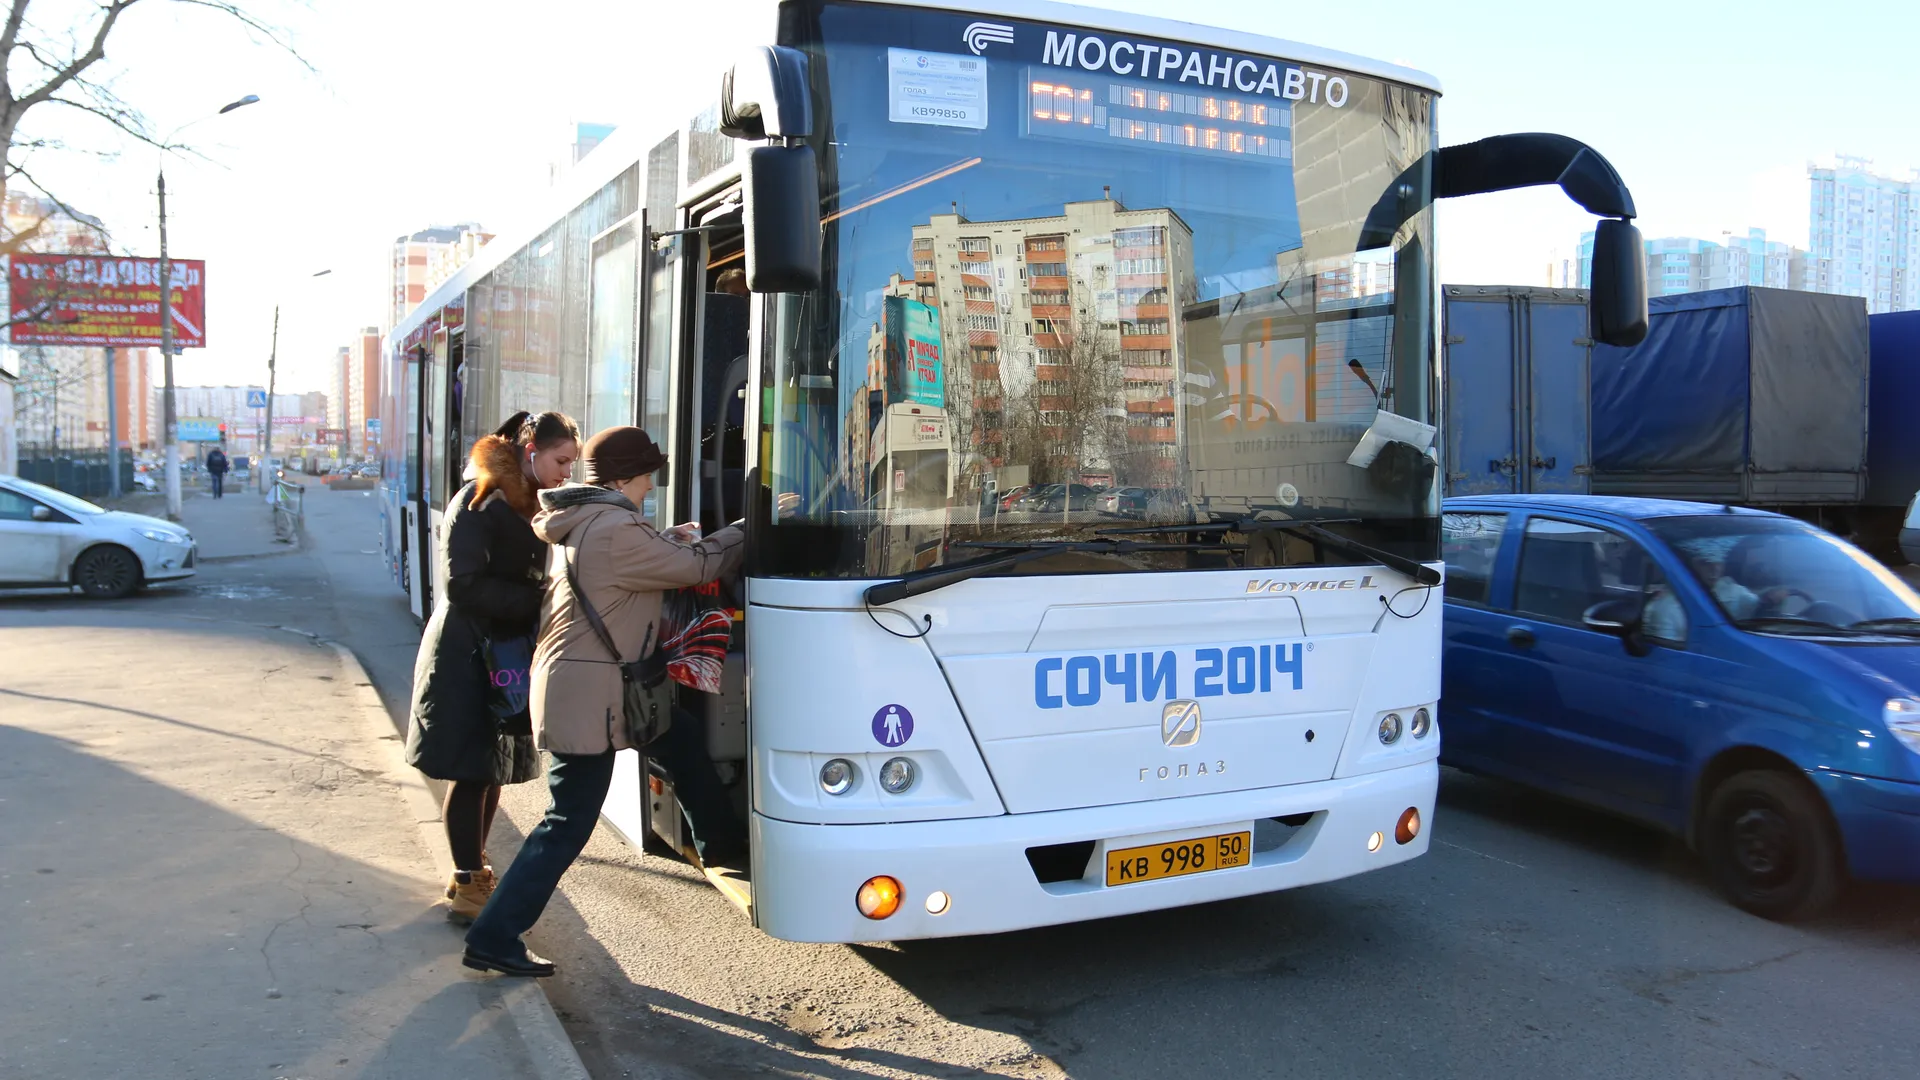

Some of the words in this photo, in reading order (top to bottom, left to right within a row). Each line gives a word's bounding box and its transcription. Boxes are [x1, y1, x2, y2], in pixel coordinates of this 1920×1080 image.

[1042, 30, 1348, 109] МОСТРАНСАВТО
[903, 86, 927, 95] ГОЛАЗ
[1245, 579, 1356, 594] VOYAGE
[1359, 575, 1379, 591] L
[1035, 650, 1177, 710] СОЧИ
[1194, 643, 1303, 698] 2014
[1139, 759, 1226, 783] ГОЛАЗ
[1219, 836, 1242, 857] 50
[1161, 843, 1205, 874] 998
[1221, 856, 1239, 866] RUS
